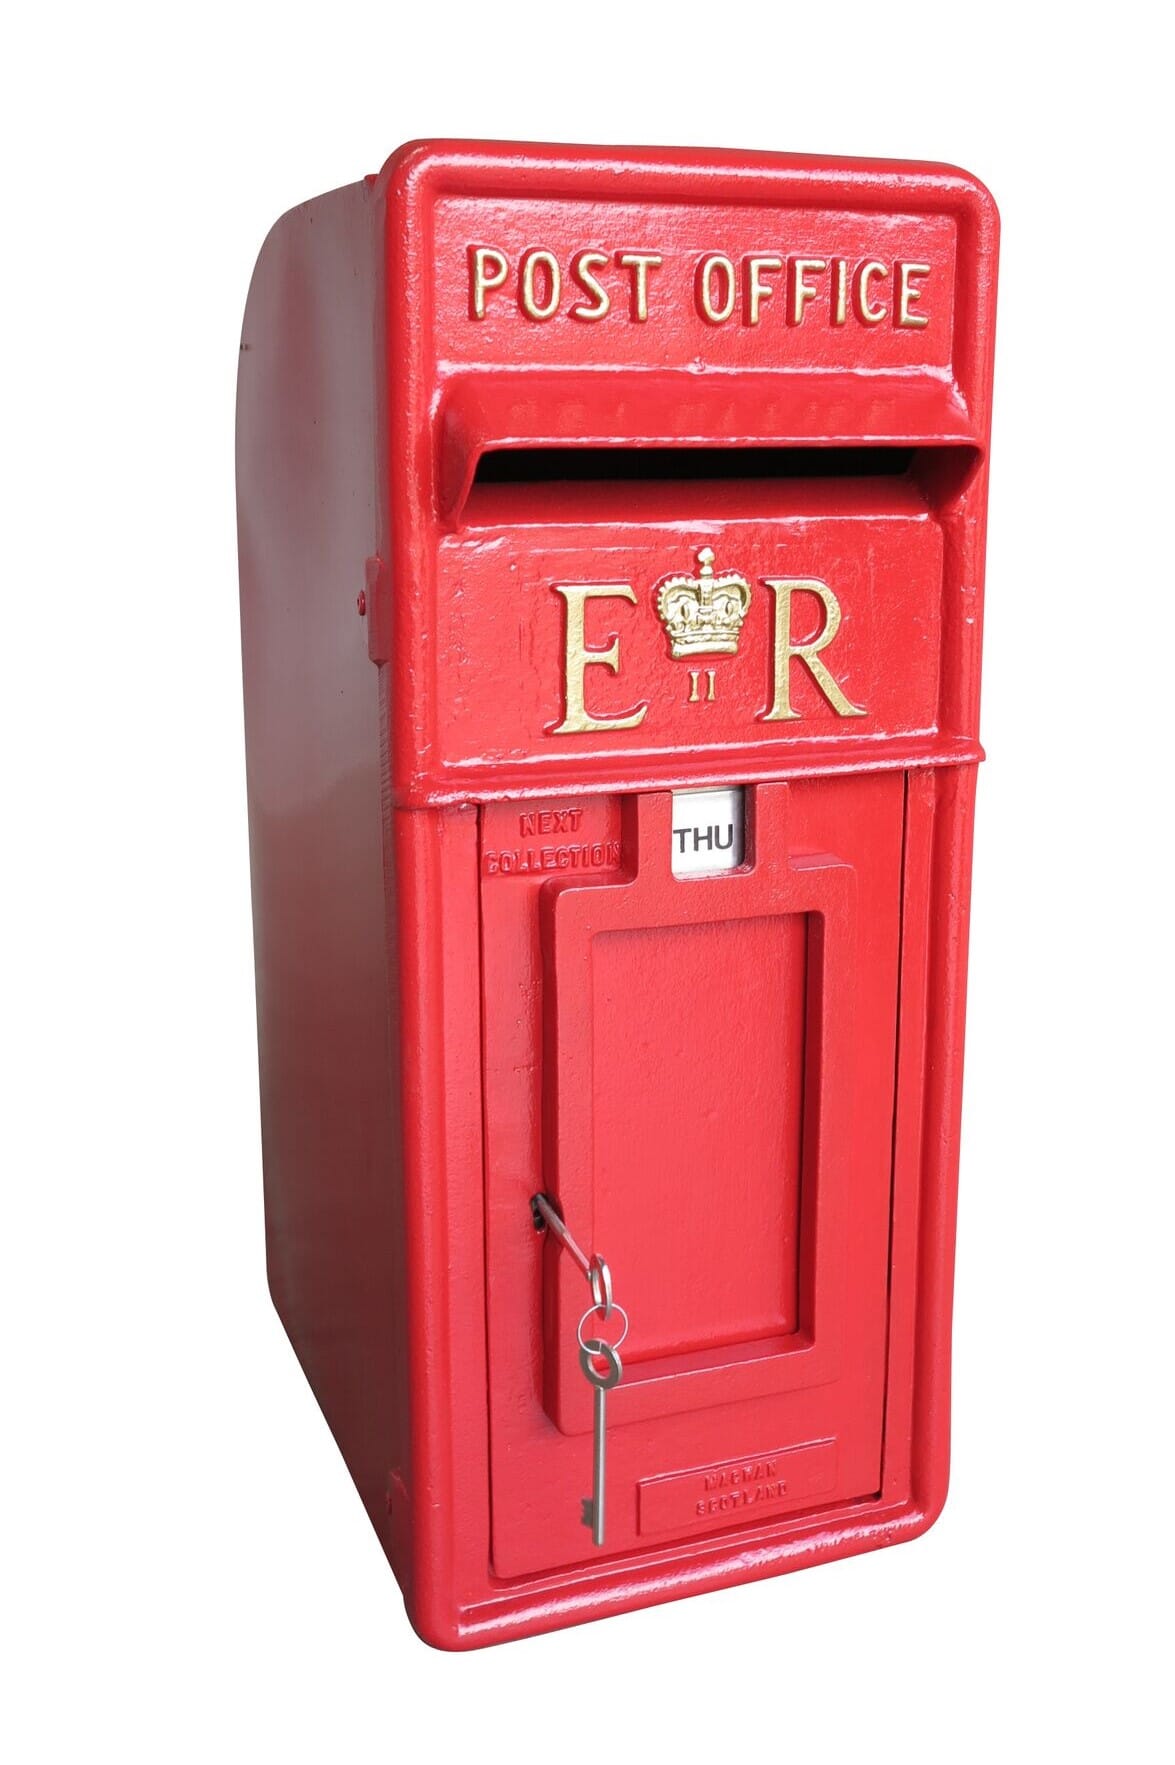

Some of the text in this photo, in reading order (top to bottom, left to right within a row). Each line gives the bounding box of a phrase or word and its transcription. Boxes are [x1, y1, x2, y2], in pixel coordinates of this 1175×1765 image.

[471, 245, 931, 326] POST OFFICE
[552, 579, 869, 734] E R
[688, 670, 716, 702] II
[519, 808, 583, 838] NEXT
[673, 824, 734, 853] THU
[484, 842, 622, 874] COLLECTION
[695, 1480, 787, 1515] SCOTLAND
